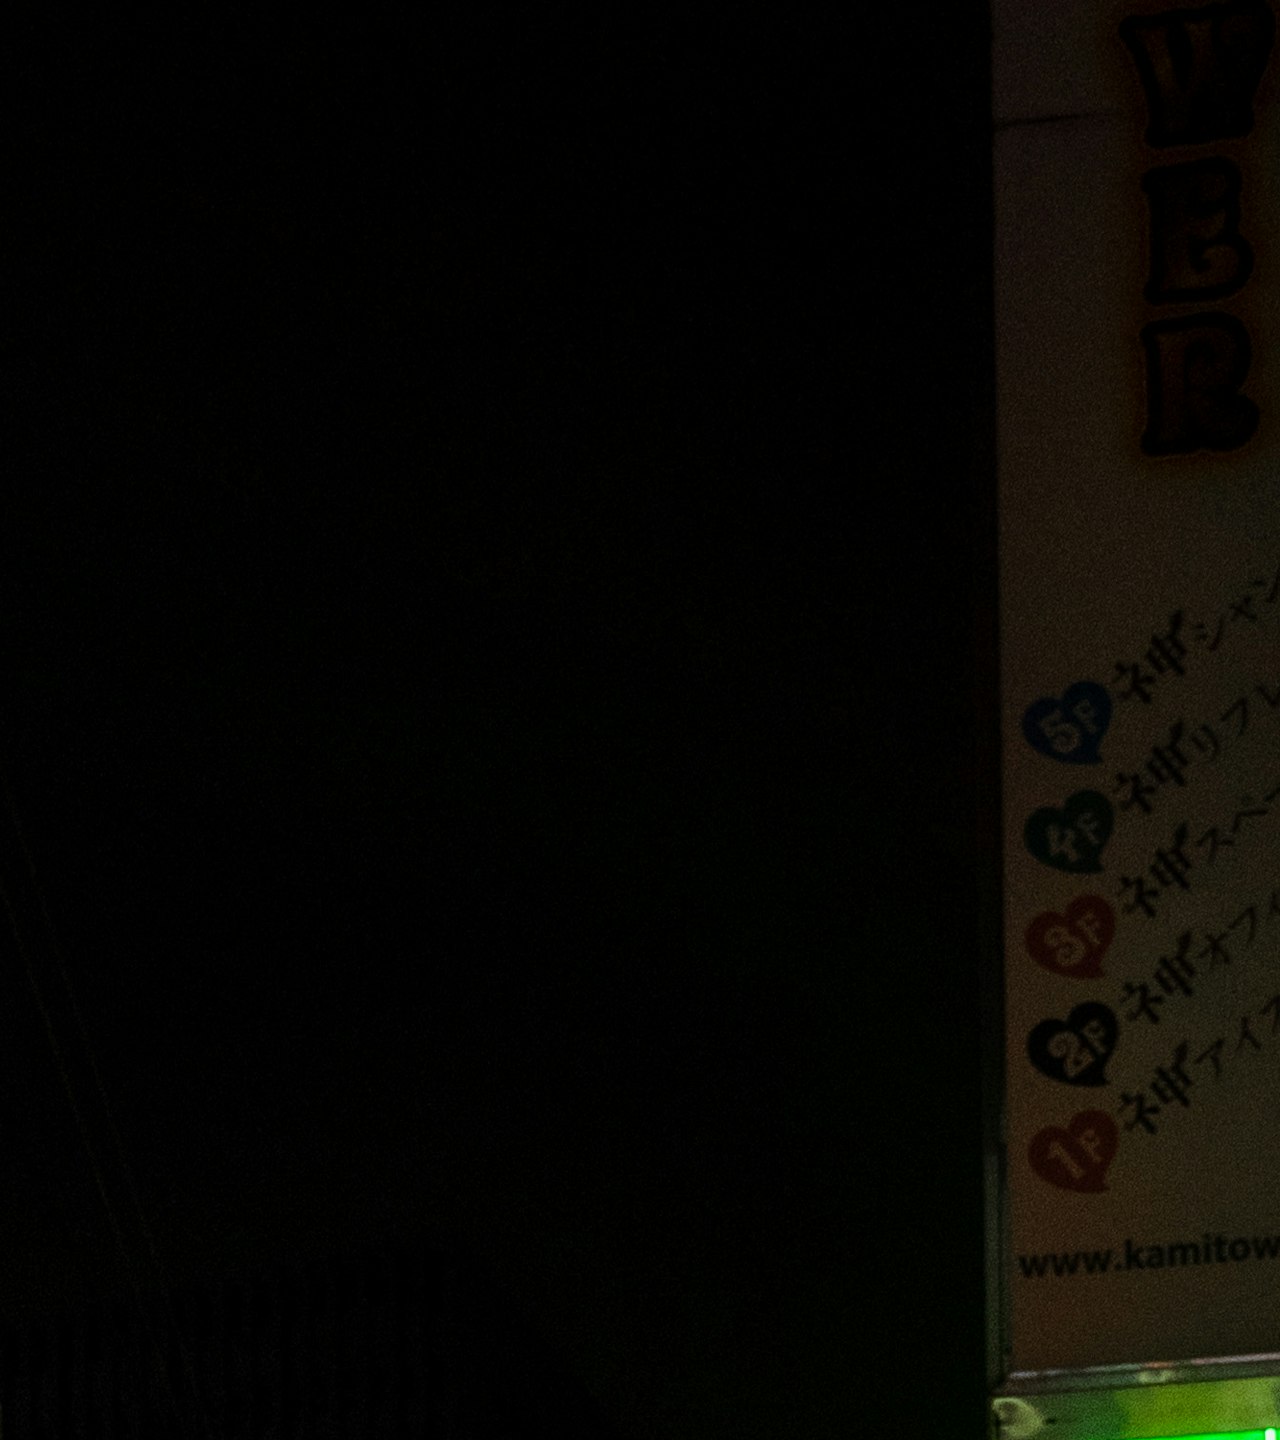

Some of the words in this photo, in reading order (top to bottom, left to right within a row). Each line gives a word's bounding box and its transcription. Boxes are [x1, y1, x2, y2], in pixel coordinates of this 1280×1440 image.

[1040, 690, 1110, 757] 5F
[1045, 800, 1108, 865] 4F
[1043, 905, 1108, 972] 3F
[1048, 1015, 1112, 1080] 2F
[1048, 1120, 1108, 1182] 1F
